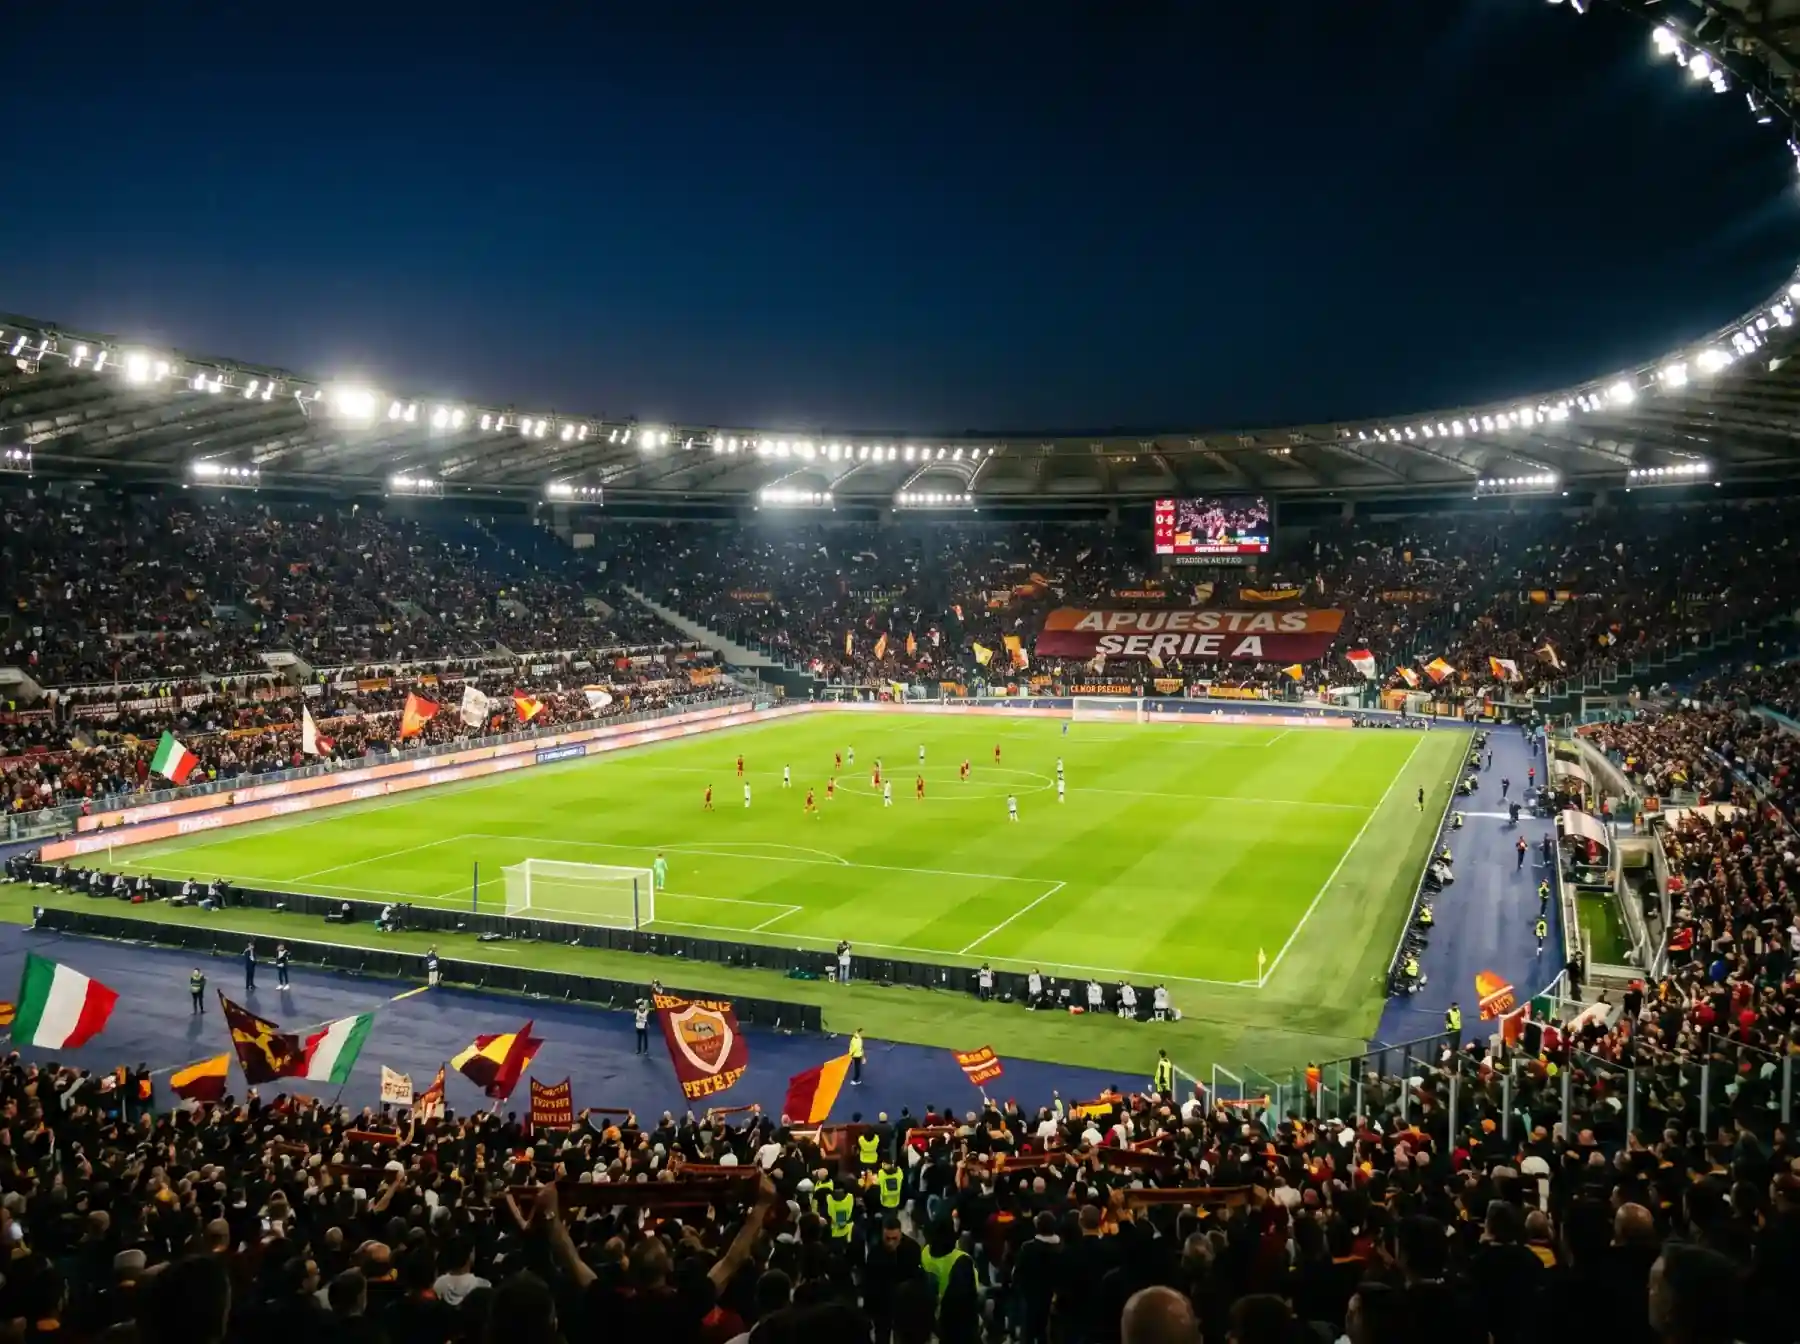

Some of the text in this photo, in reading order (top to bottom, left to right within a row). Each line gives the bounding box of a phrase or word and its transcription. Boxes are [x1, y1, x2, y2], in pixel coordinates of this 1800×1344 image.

[1075, 611, 1308, 632] APUESTAS
[1096, 634, 1263, 657] SERIE A
